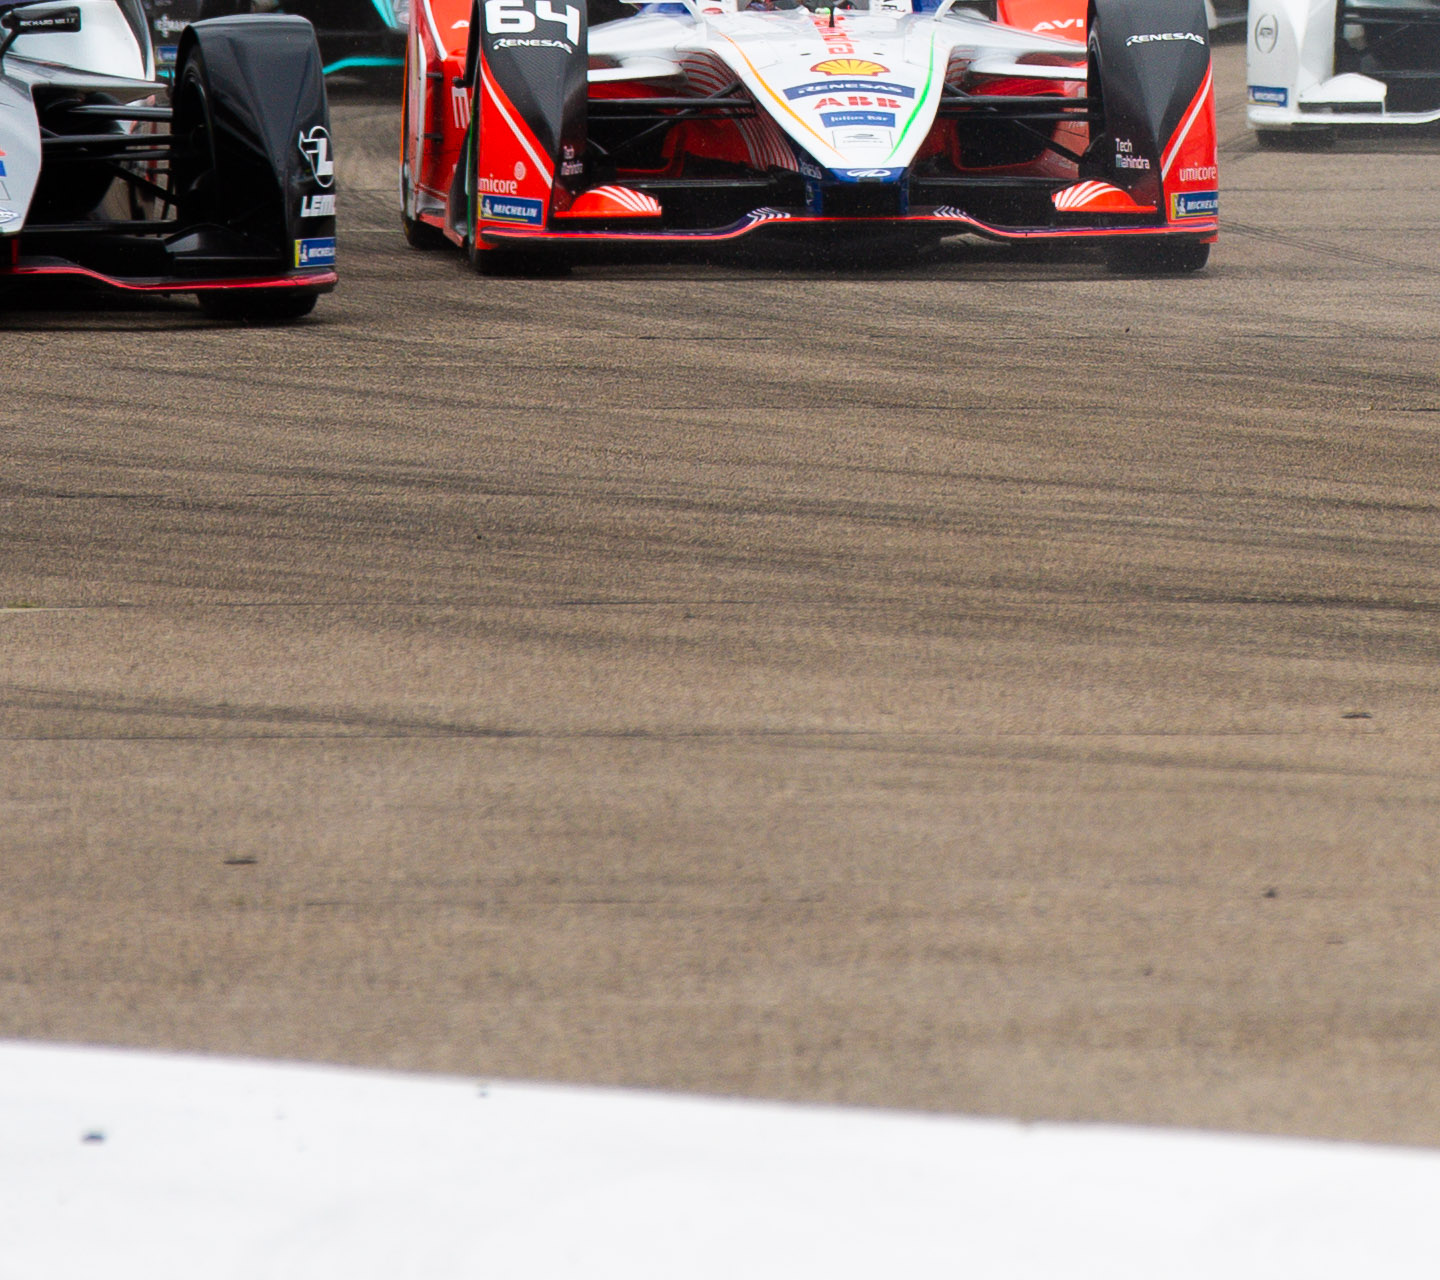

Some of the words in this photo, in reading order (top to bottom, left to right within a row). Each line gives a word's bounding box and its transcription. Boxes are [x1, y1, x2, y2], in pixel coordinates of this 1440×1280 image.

[20, 19, 53, 27] RICHARD
[55, 17, 76, 26] MILLE
[485, 0, 580, 46] 64
[493, 38, 573, 54] RENESAS
[1125, 32, 1205, 46] RENESAS
[798, 83, 903, 94] RENESAS
[813, 96, 902, 109] ABB
[1115, 137, 1132, 153] Tech
[1115, 153, 1150, 169] Mahindra
[478, 173, 518, 194] micore
[301, 195, 335, 218] LEM
[493, 203, 537, 218] MICHELIN
